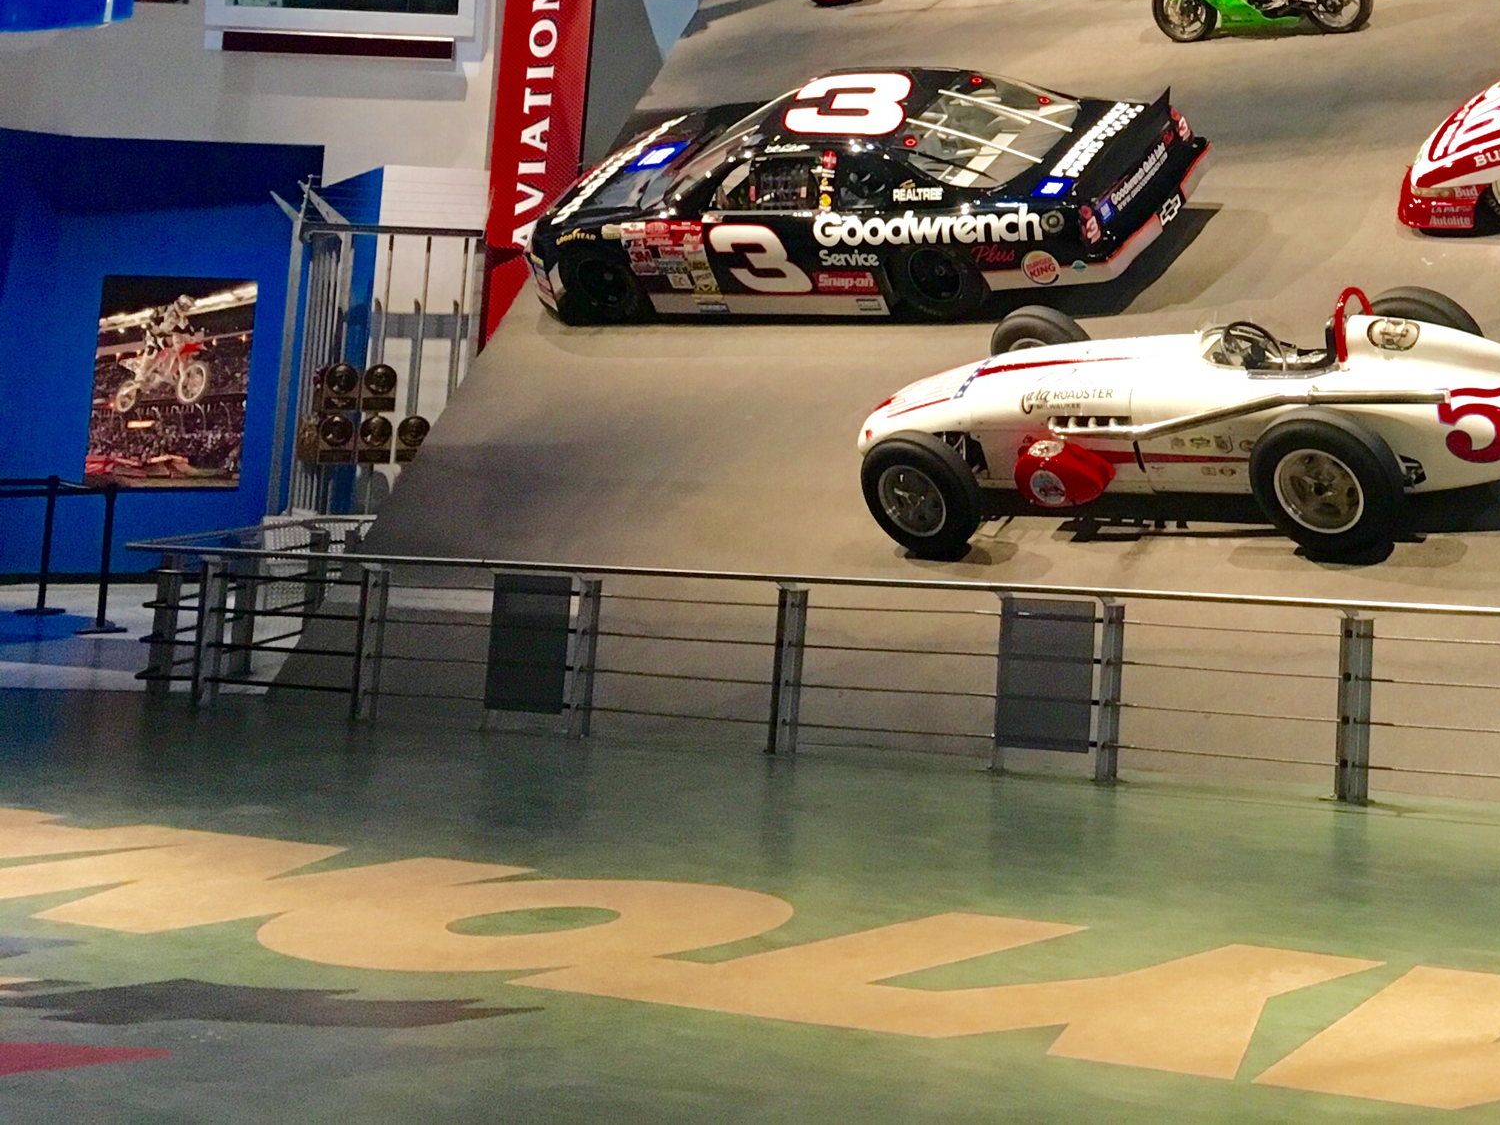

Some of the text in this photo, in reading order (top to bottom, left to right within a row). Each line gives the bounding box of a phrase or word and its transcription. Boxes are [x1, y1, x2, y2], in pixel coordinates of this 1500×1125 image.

[783, 72, 912, 136] 3
[892, 187, 944, 202] REALTREE
[1453, 184, 1479, 198] Bud
[813, 206, 1044, 247] Goodwrench
[708, 224, 813, 294] 3
[818, 249, 880, 268] Service
[1030, 263, 1056, 279] KING
[818, 274, 875, 289] Snap-on
